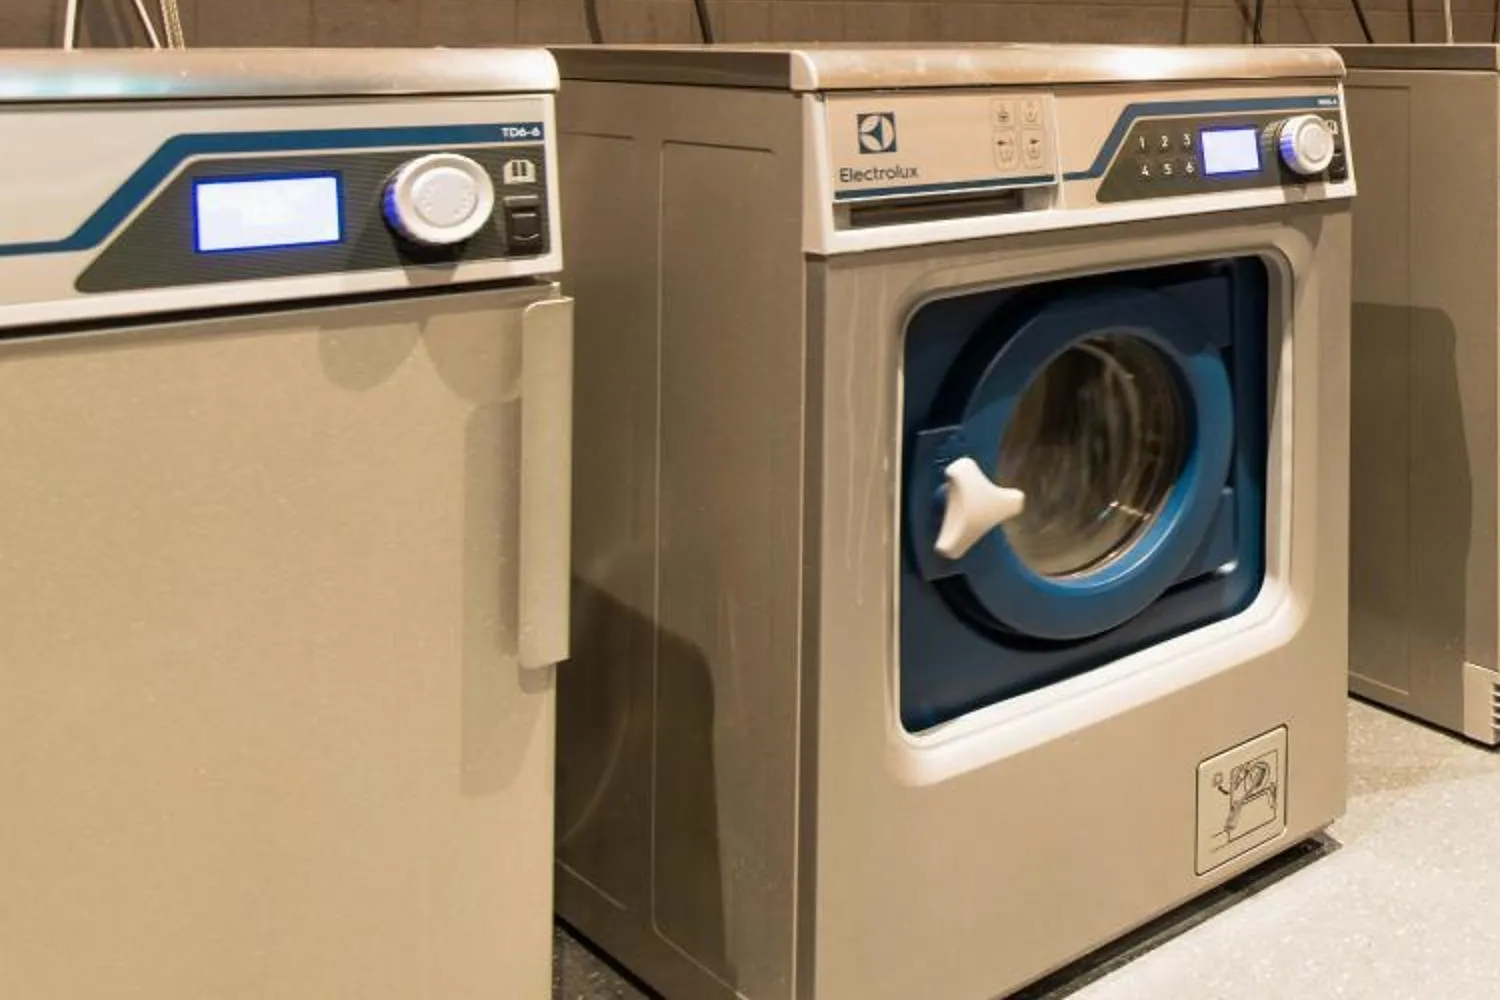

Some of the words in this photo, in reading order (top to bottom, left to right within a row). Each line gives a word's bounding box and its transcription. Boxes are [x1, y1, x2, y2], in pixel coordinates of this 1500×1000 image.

[1139, 136, 1146, 149] 1
[1161, 135, 1169, 148] 2
[1183, 133, 1191, 146] 3
[839, 164, 919, 183] Electrolux
[1141, 164, 1149, 176] 4
[1164, 163, 1172, 175] 5
[1186, 162, 1194, 174] 6
